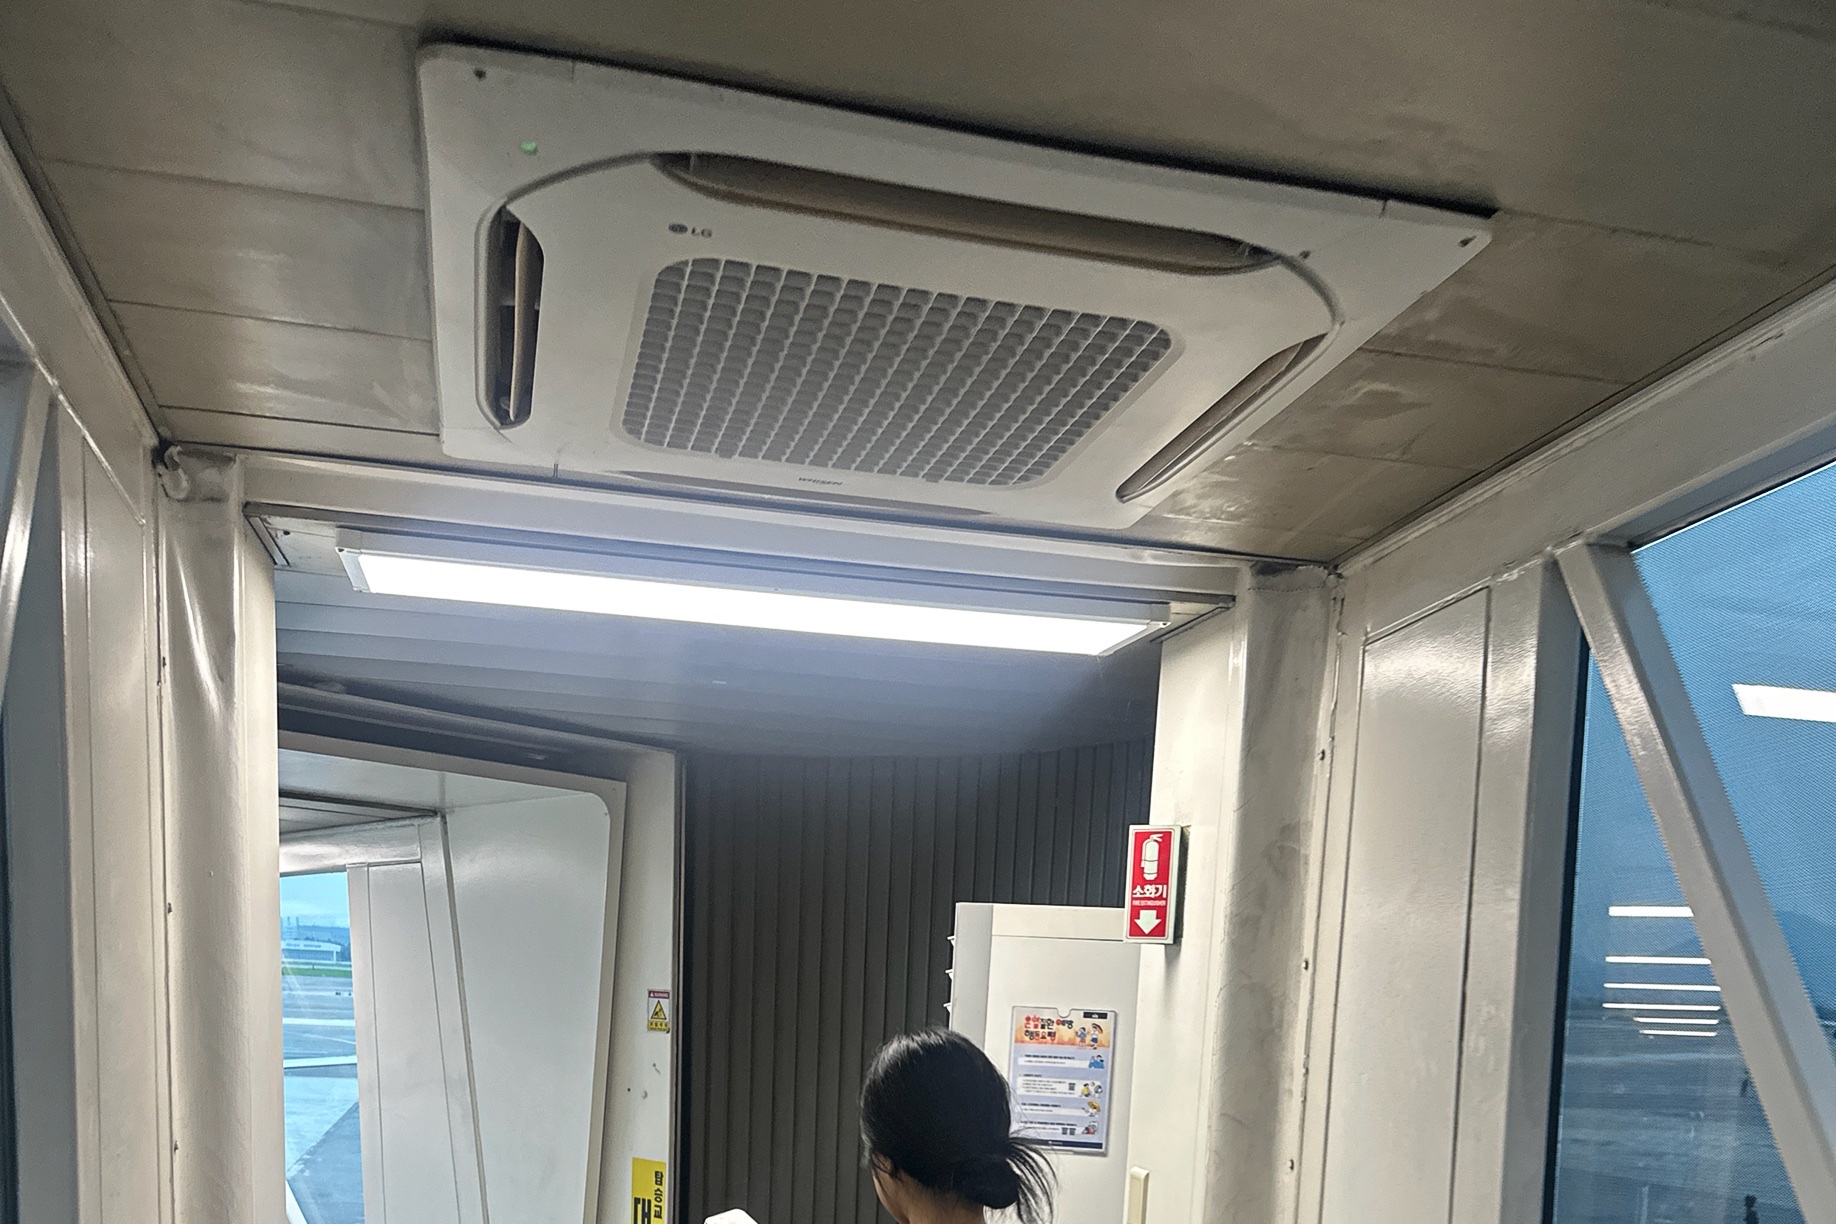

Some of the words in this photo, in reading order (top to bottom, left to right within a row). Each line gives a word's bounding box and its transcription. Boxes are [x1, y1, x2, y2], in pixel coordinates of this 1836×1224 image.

[690, 227, 712, 238] LG
[1131, 884, 1168, 898] 소화기
[653, 1170, 664, 1220] 탑승교
